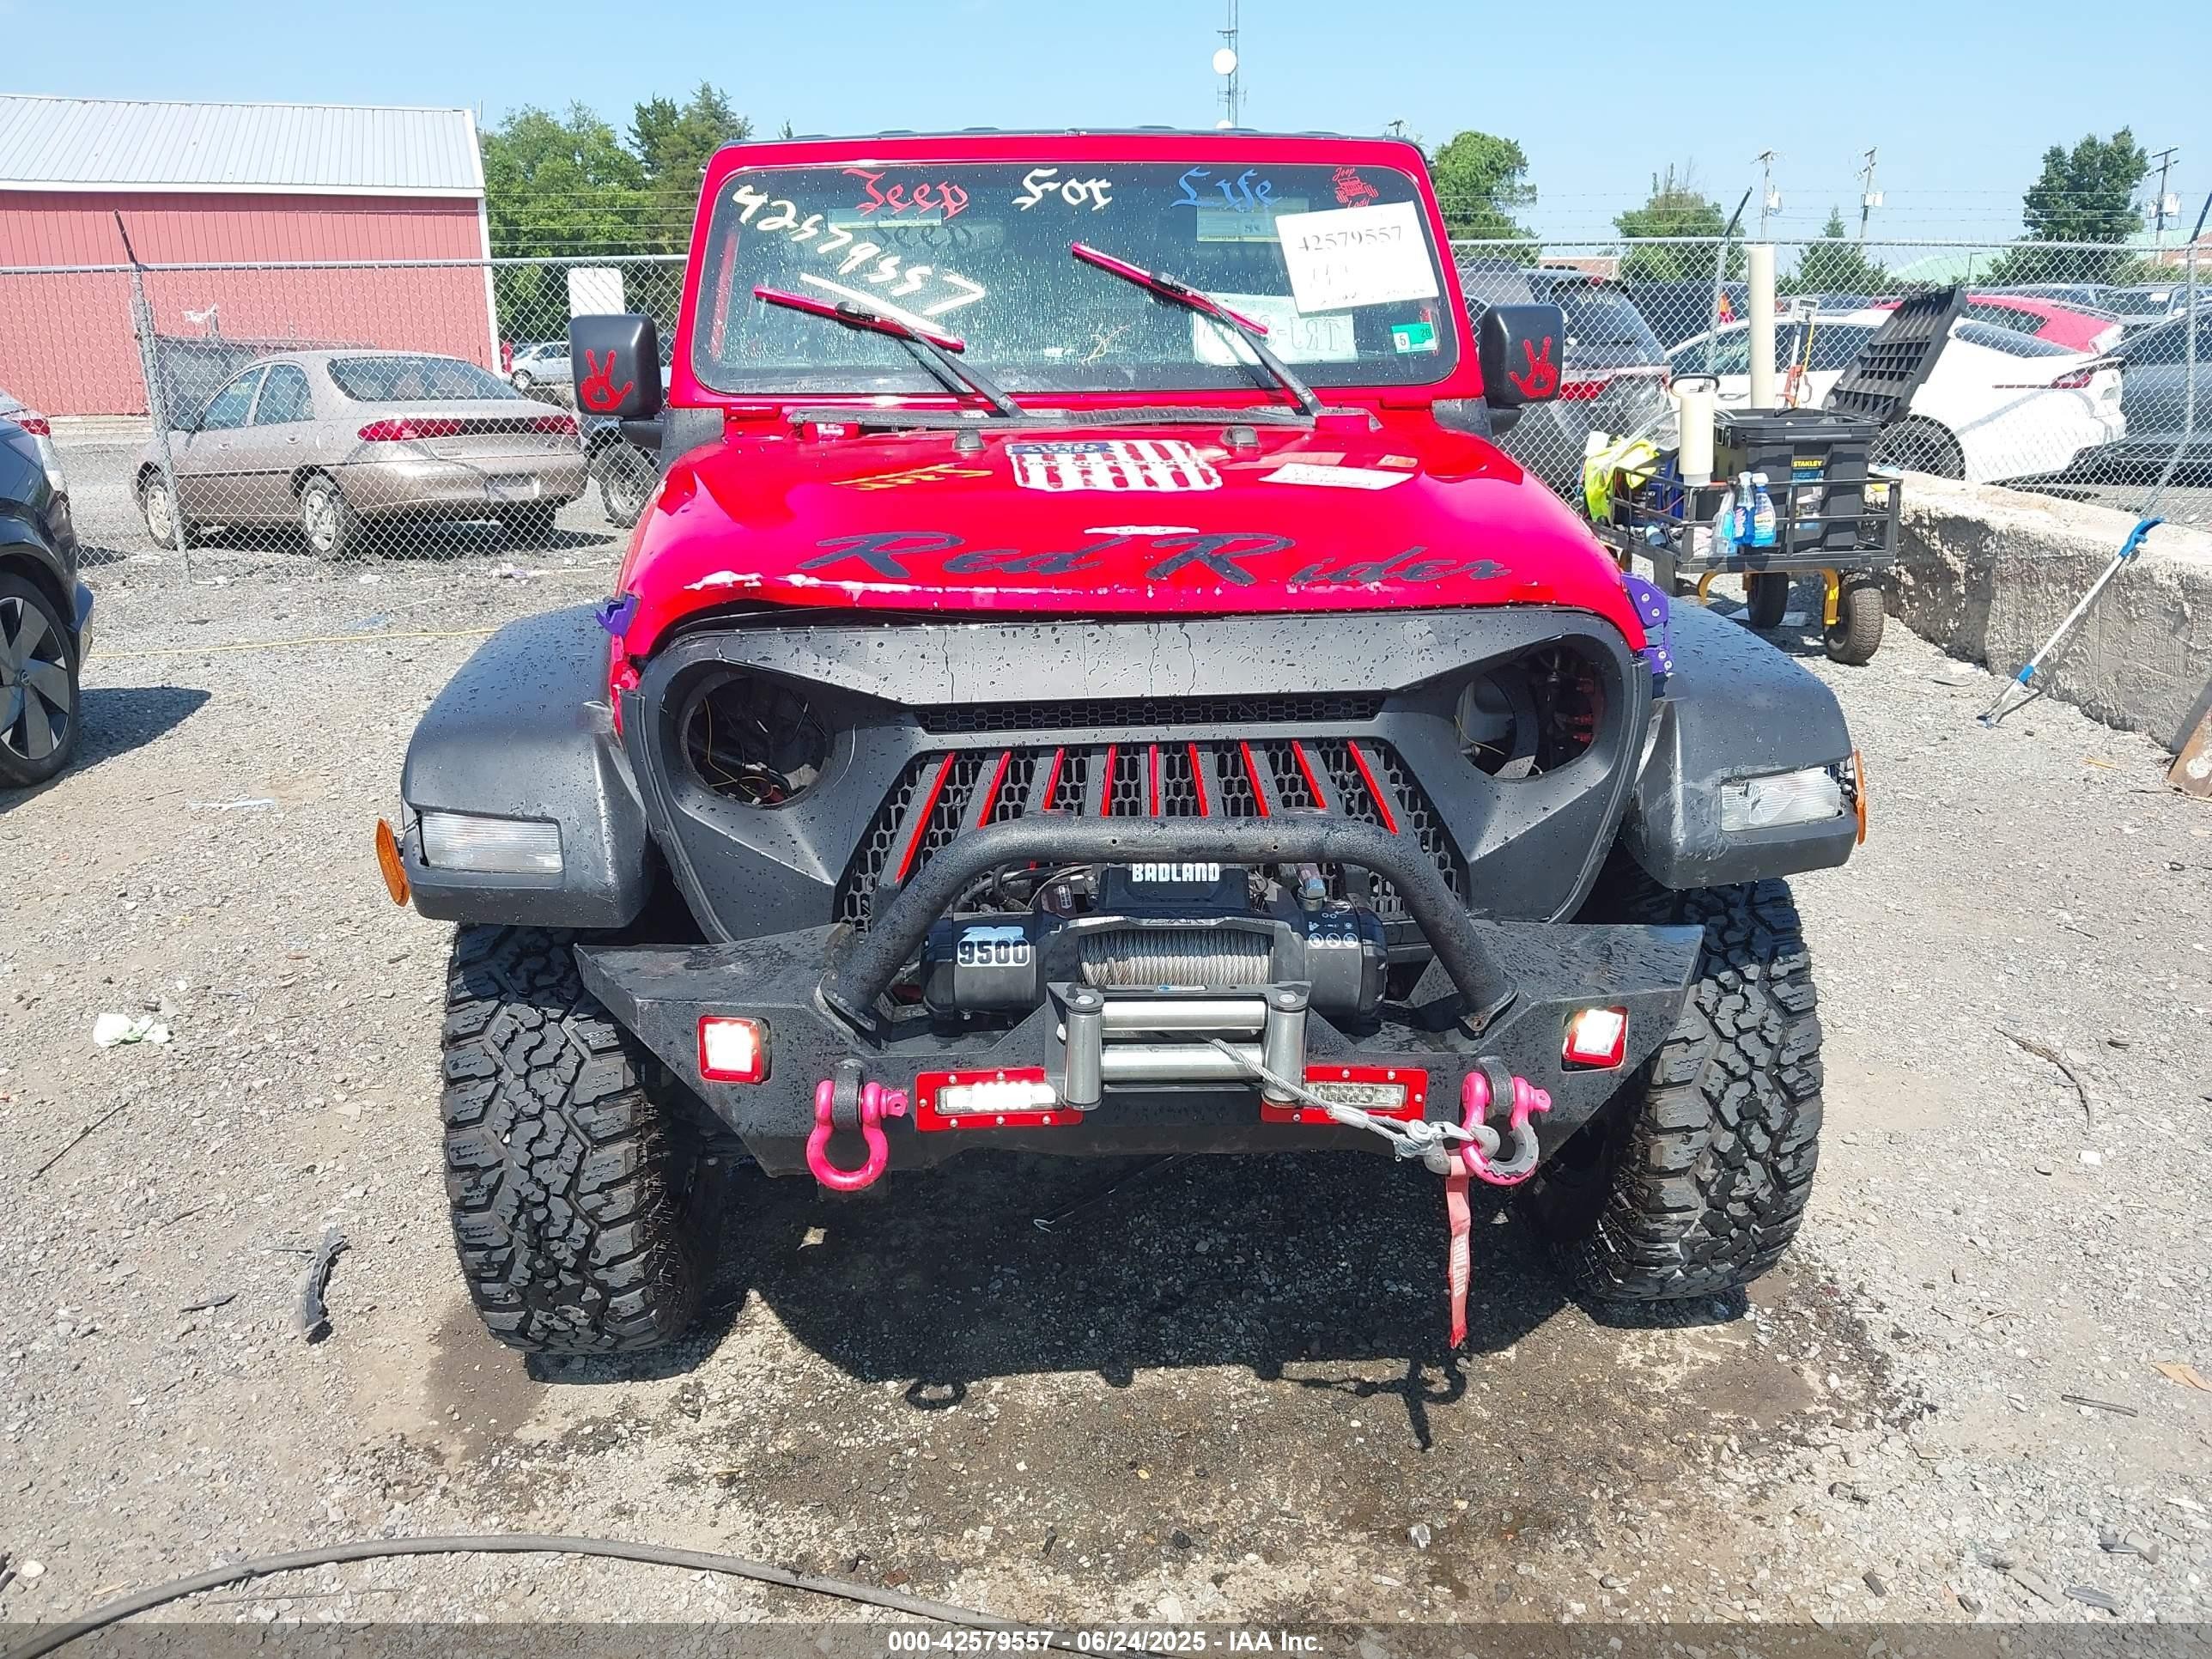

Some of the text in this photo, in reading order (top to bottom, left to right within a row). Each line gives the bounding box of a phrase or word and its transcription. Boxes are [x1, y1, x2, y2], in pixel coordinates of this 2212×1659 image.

[1333, 166, 1355, 181] Jeep
[842, 166, 1282, 220] Jeep For Life
[732, 185, 986, 315] 42579557
[1297, 225, 1402, 252] 42579557
[796, 531, 1511, 586] Red Rider
[1132, 863, 1220, 882] BADLAND
[958, 939, 1029, 964] 9500
